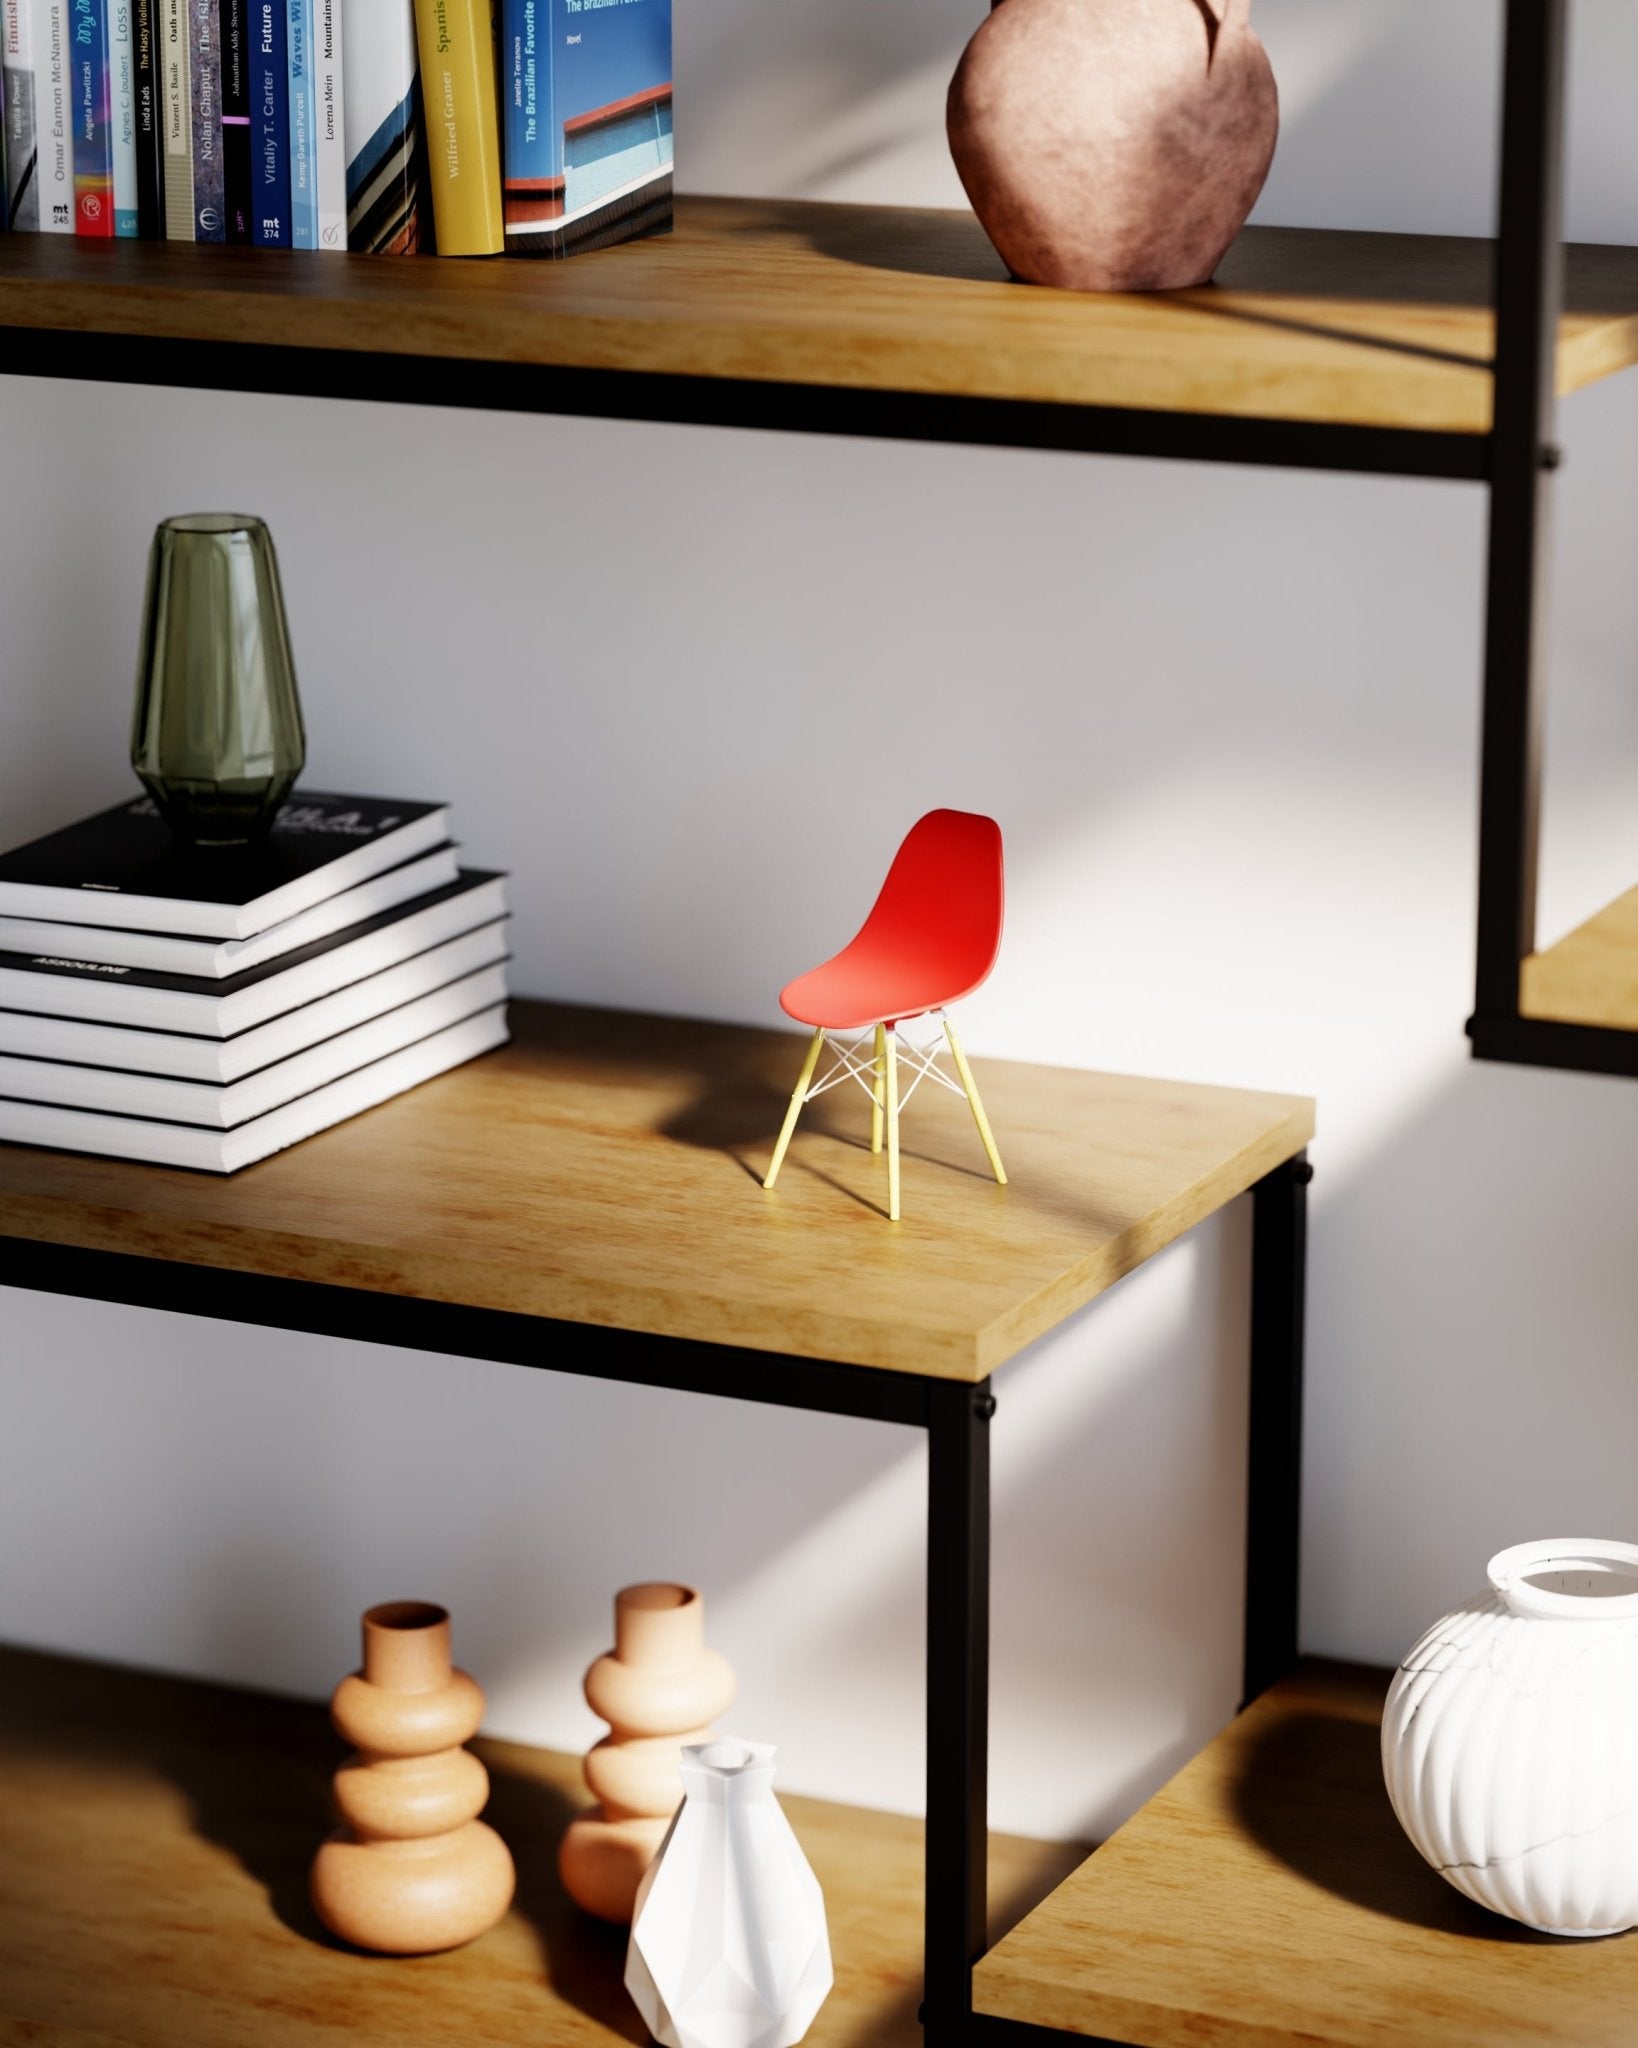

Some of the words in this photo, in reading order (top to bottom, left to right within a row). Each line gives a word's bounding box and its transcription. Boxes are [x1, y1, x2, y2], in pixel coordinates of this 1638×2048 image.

[77, 16, 97, 45] My
[116, 6, 128, 42] Loss
[139, 28, 150, 51] Hasty
[169, 18, 178, 42] Oath
[199, 25, 210, 53] The
[230, 28, 240, 50] Addy
[262, 4, 273, 53] Future
[323, 0, 334, 59] Mountains
[524, 1, 535, 54] Favorite
[566, 33, 582, 45] Novel
[51, 6, 62, 83] McNamara
[292, 27, 303, 79] Waves
[514, 36, 522, 77] Terranova
[120, 55, 130, 94] Joubert
[140, 53, 149, 70] The
[170, 62, 179, 89] Basile
[231, 51, 240, 96] Johnathan
[12, 74, 22, 105] Power
[82, 61, 93, 106] Pawlitzki
[141, 86, 150, 106] Eads
[171, 91, 180, 101] S.
[200, 67, 213, 117] Chaput
[263, 70, 274, 117] Carter
[324, 75, 333, 101] Mein
[443, 70, 455, 118] Graner
[514, 78, 522, 107] Janelle
[524, 59, 536, 115] Brazilian
[51, 87, 63, 138] Éamon
[85, 108, 95, 141] Angela
[142, 107, 151, 131] Linda
[172, 103, 180, 139] Vinzent
[295, 92, 305, 126] Purcell
[325, 104, 335, 141] Lorena
[121, 113, 132, 145] Agnes
[201, 121, 213, 160] Nolan
[263, 121, 275, 135] T.
[296, 127, 305, 160] Gareth
[525, 118, 536, 143] The
[55, 142, 64, 181] Omar
[264, 138, 278, 184] Vitaliy
[446, 121, 459, 178] Wilfried
[296, 162, 306, 188] Kemp
[53, 204, 69, 214] mt
[53, 214, 69, 225] 245
[263, 217, 280, 228] mt
[263, 229, 280, 239] 374
[32, 957, 130, 974] ASSOULINE
